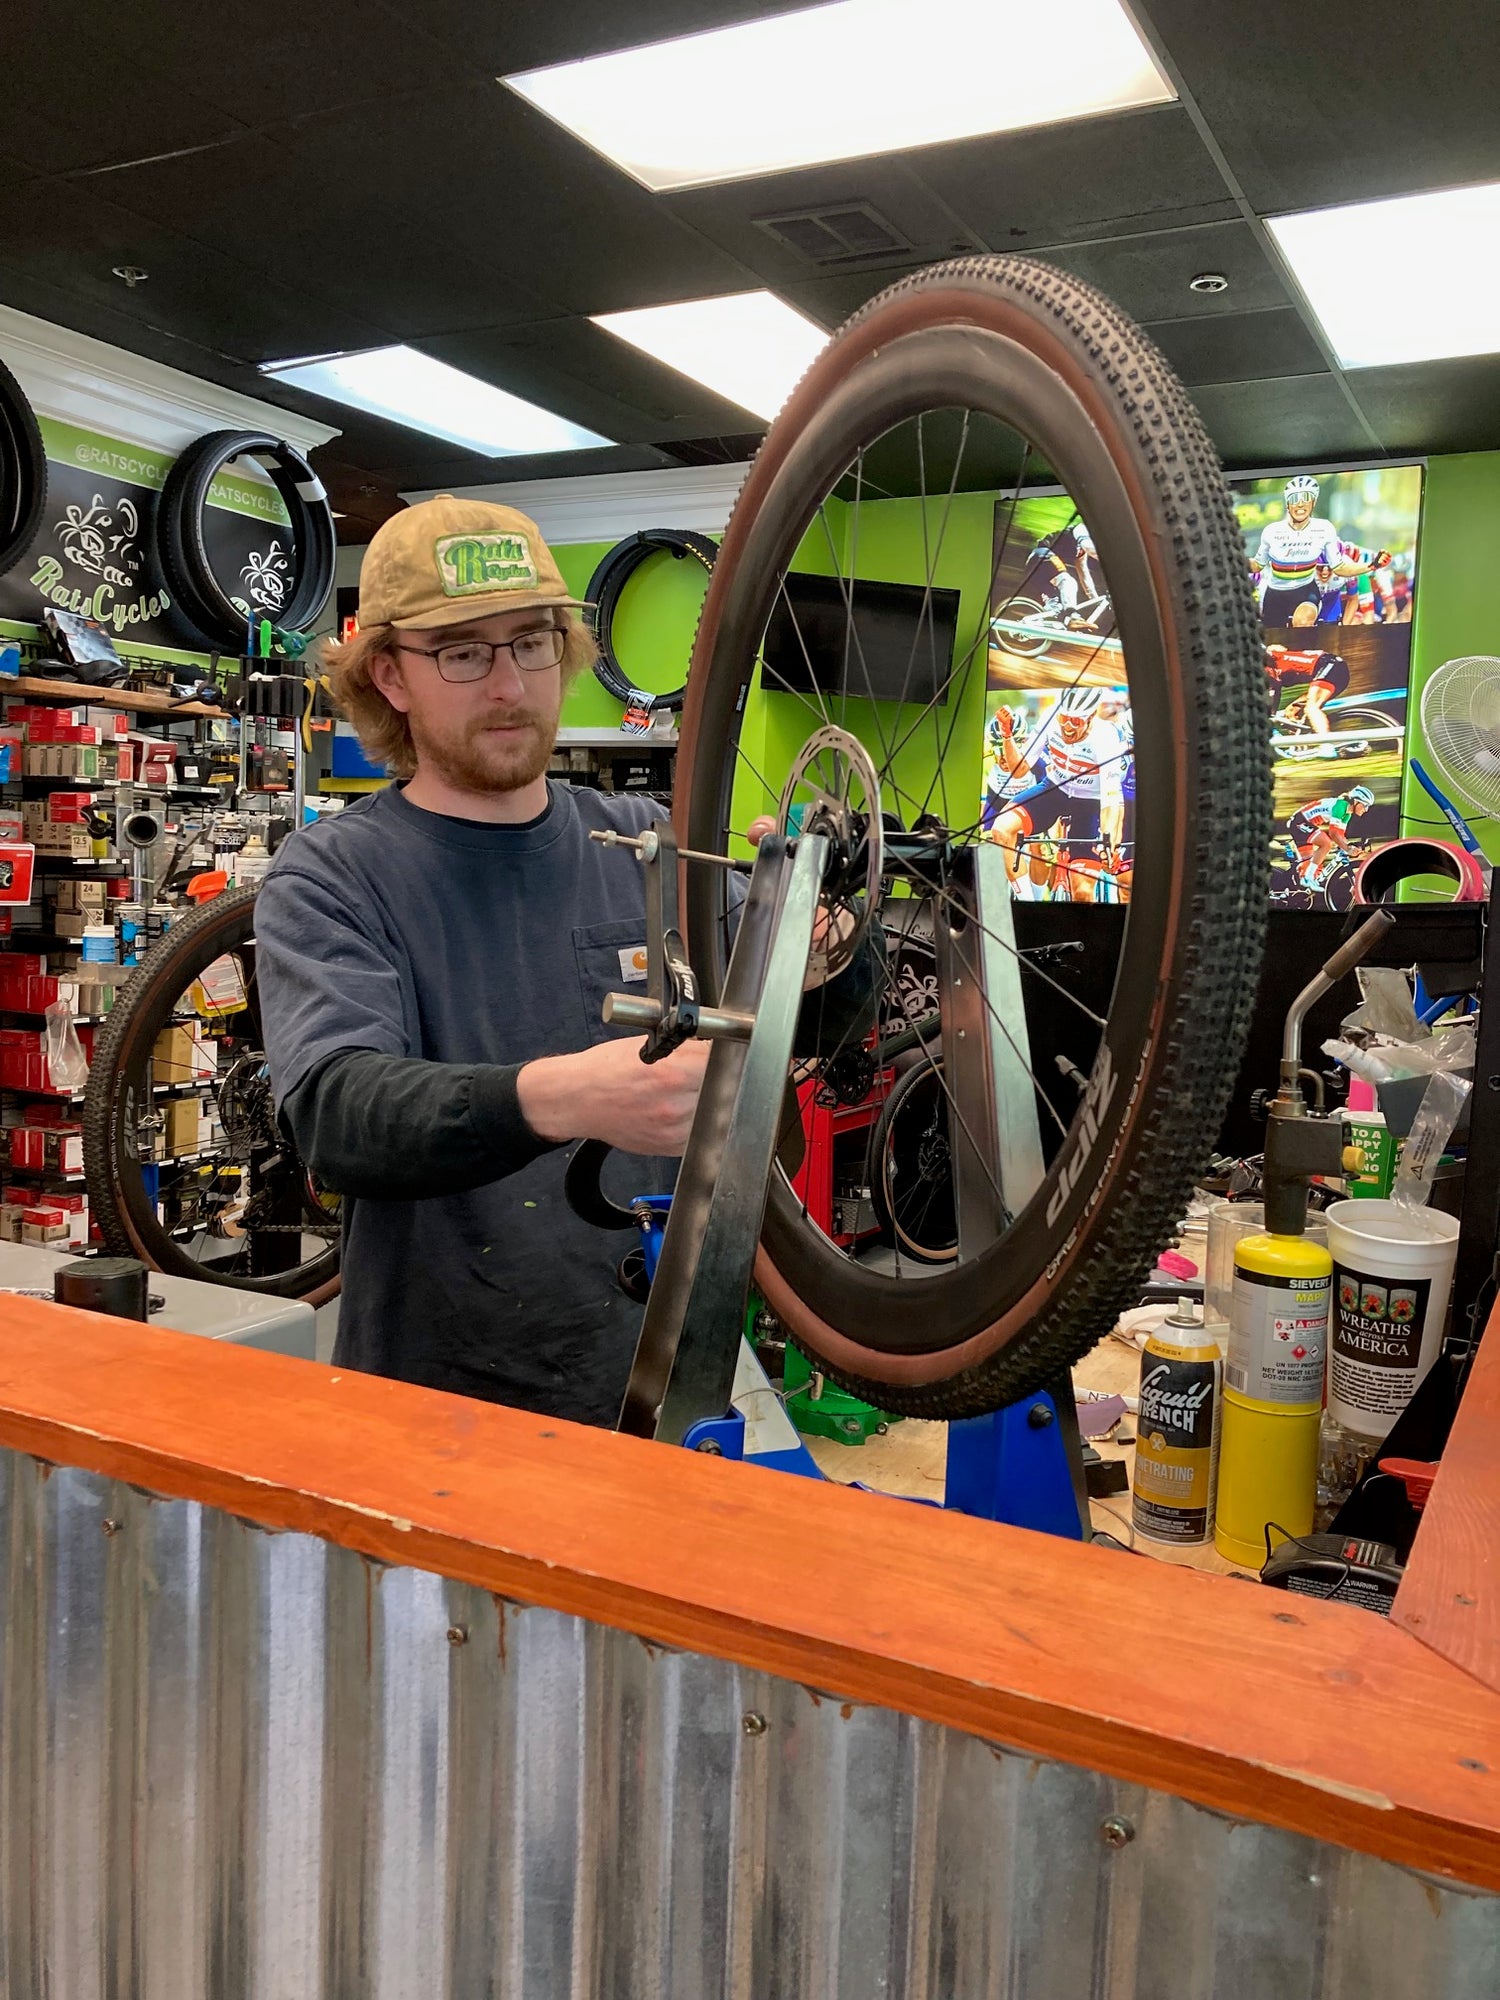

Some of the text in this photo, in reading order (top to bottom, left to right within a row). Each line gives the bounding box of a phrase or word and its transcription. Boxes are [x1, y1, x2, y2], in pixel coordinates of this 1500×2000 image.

[75, 443, 170, 481] @RATSCYCLE
[83, 883, 94, 893] 24
[1371, 1130, 1382, 1139] A
[1339, 1308, 1411, 1337] WREATHS
[1338, 1329, 1410, 1357] AMERICA
[1359, 1330, 1385, 1341] across
[1140, 1364, 1212, 1412] Liquid
[1350, 1579, 1379, 1591] WARNING
